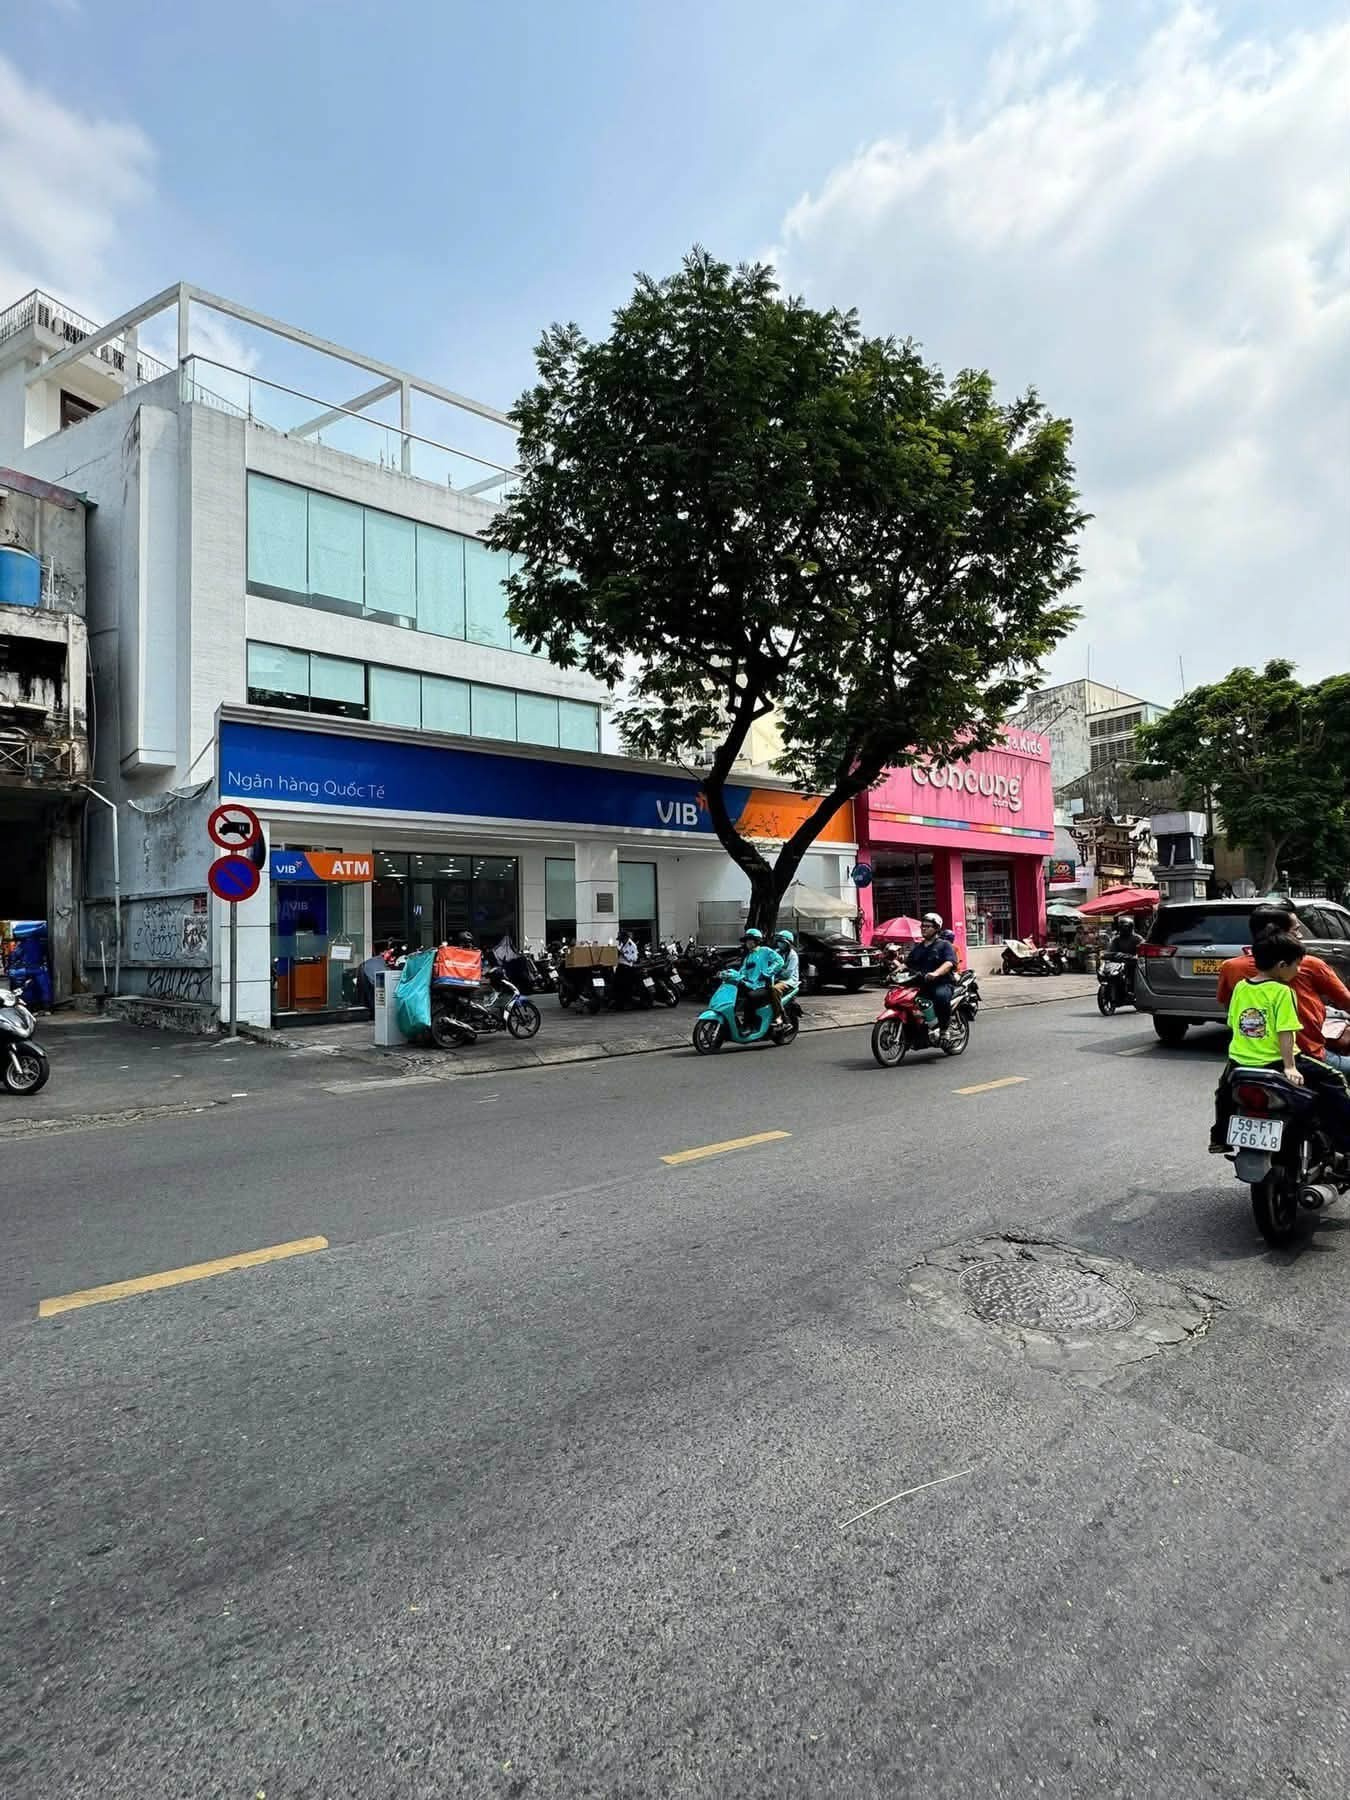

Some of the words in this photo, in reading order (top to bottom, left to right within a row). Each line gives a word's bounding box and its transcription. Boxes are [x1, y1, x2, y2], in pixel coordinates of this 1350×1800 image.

[228, 770, 273, 791] Ngân
[278, 776, 319, 797] hàng
[323, 780, 366, 798] Quốc
[368, 784, 385, 799] Tế
[656, 800, 698, 825] VIB
[275, 865, 297, 874] VIB
[331, 860, 370, 875] ATM
[289, 901, 308, 911] VIB
[1238, 1119, 1273, 1135] 59-F1
